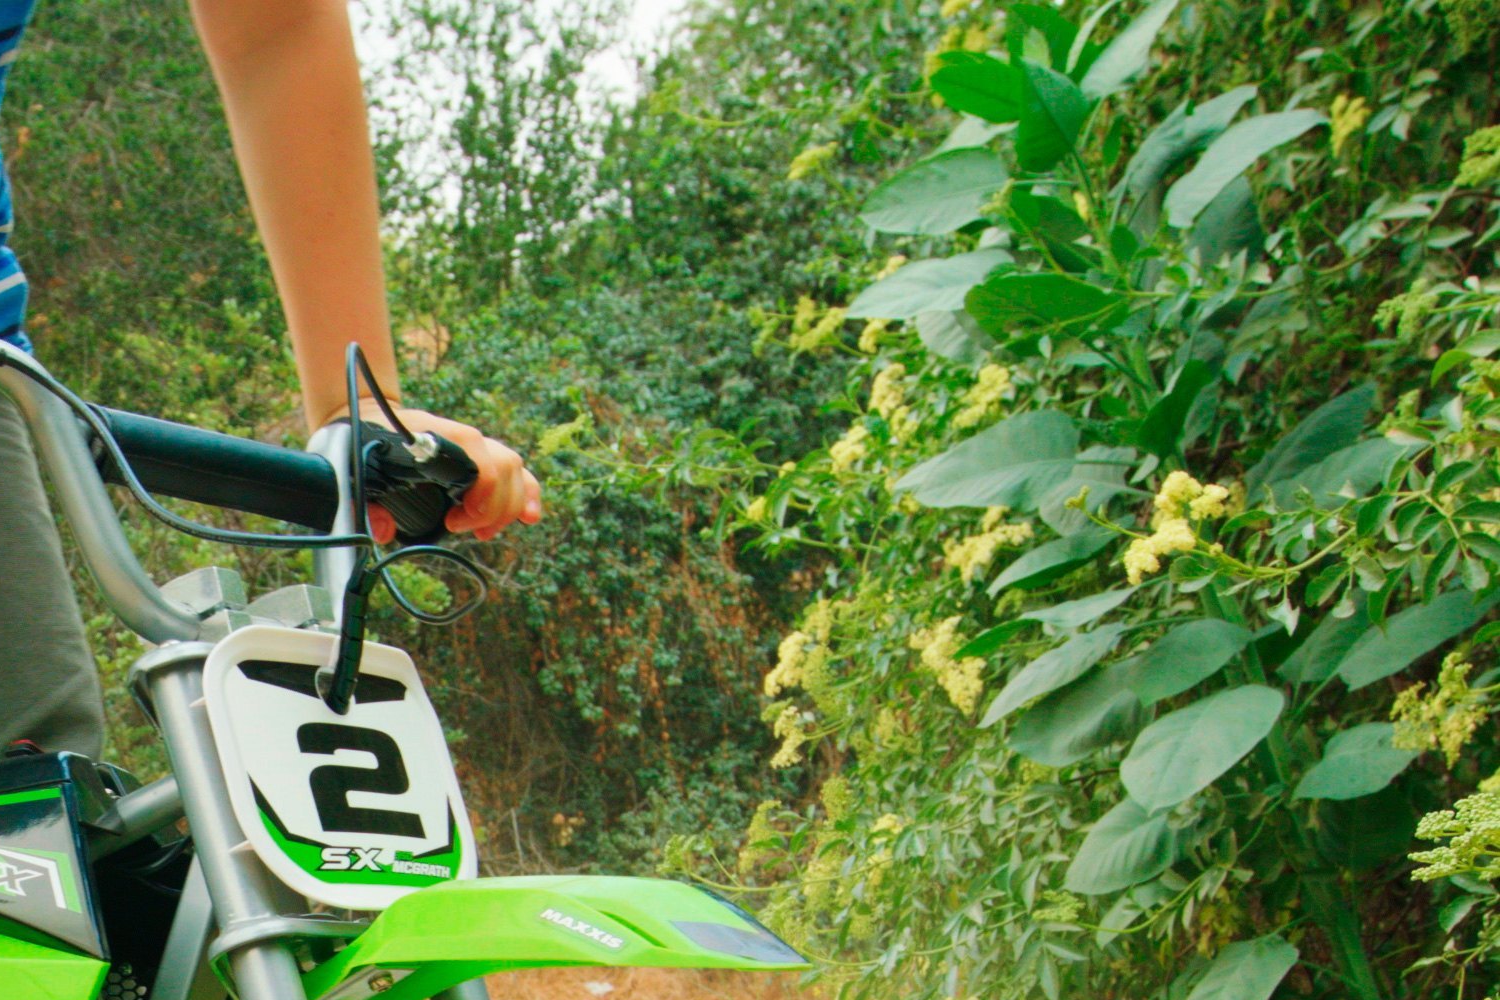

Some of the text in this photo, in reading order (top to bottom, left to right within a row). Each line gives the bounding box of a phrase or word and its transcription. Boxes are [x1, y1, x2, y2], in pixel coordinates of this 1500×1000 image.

[297, 722, 428, 839] 2
[317, 847, 385, 871] SX
[540, 908, 624, 949] MAXXIS
